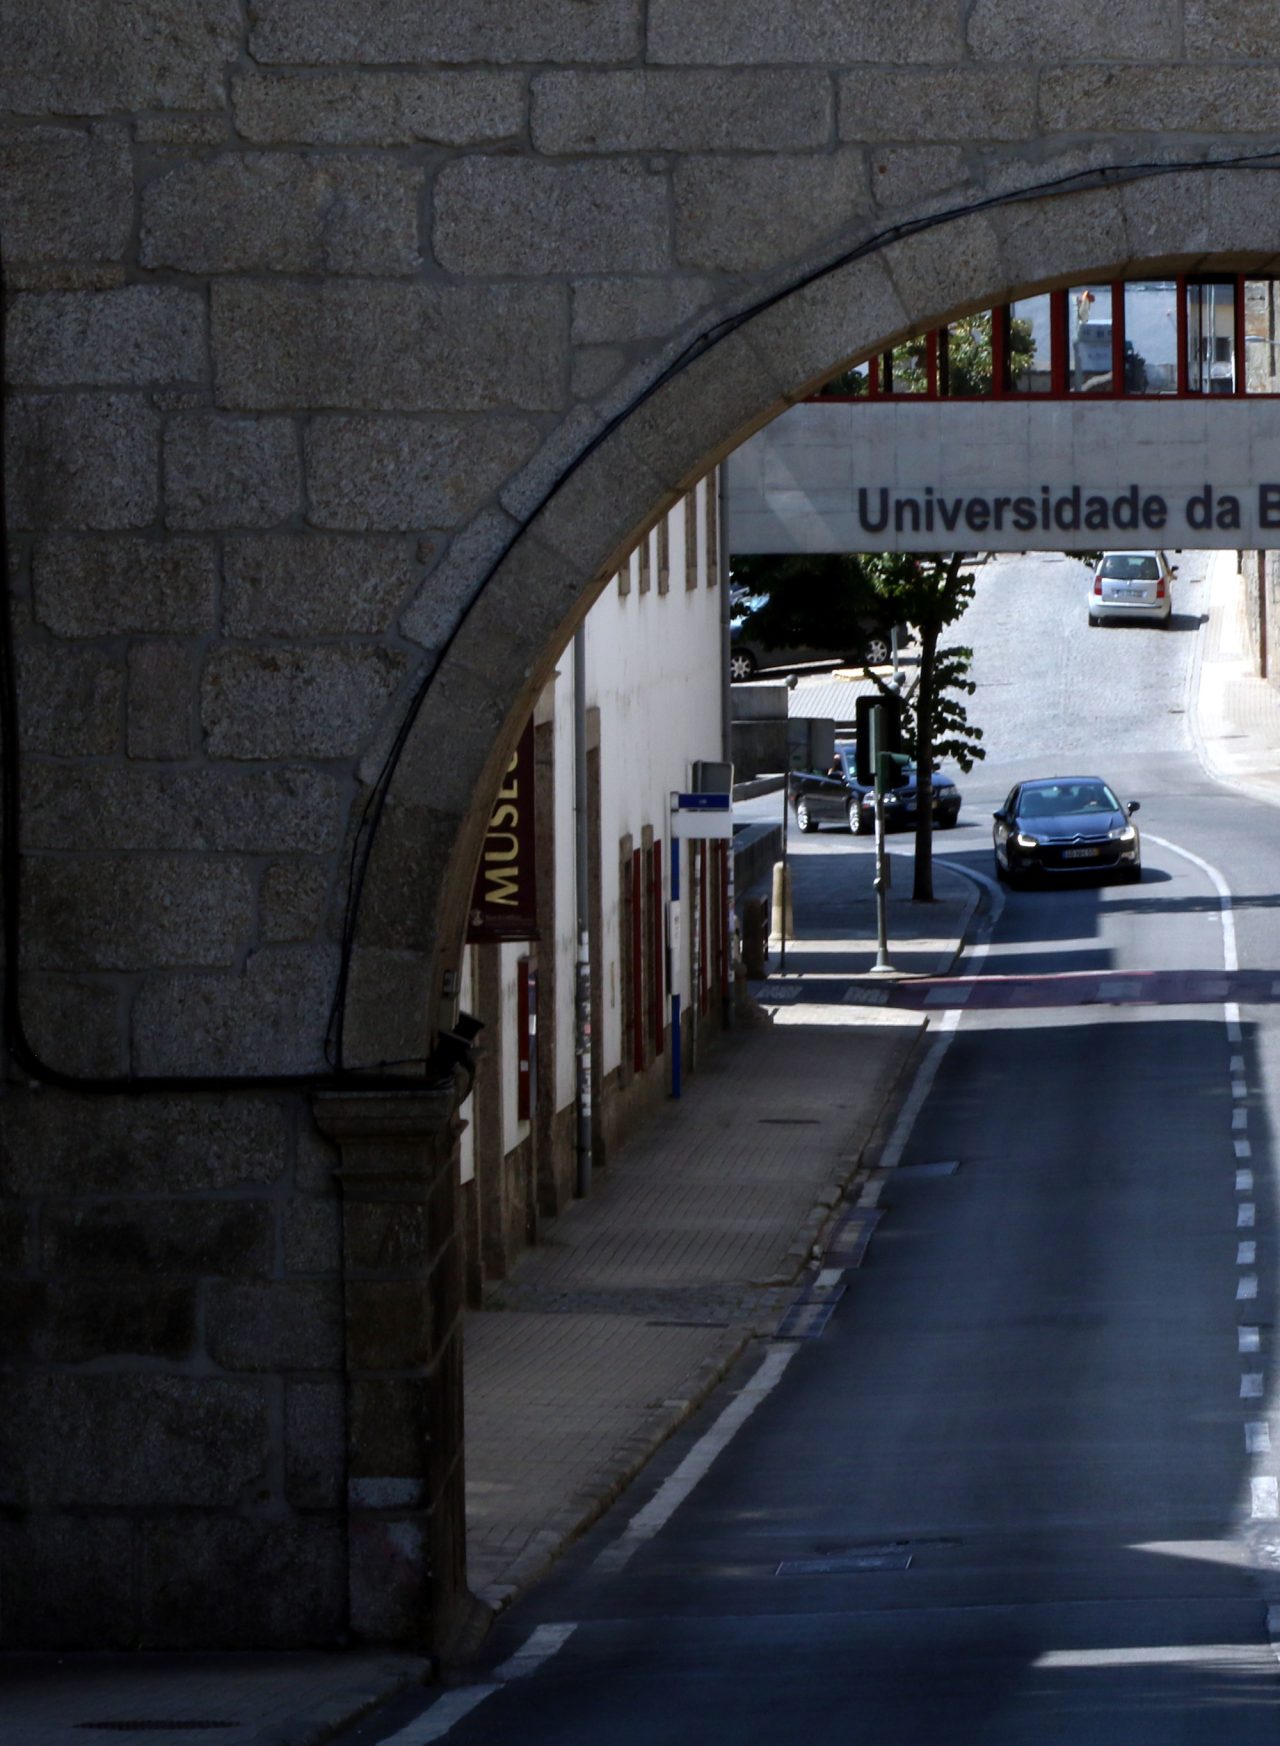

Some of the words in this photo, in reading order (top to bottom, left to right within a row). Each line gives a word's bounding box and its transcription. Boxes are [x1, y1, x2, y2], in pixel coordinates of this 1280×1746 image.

[857, 483, 1169, 535] Universidade
[1185, 483, 1242, 531] da
[485, 751, 519, 906] MUSE
